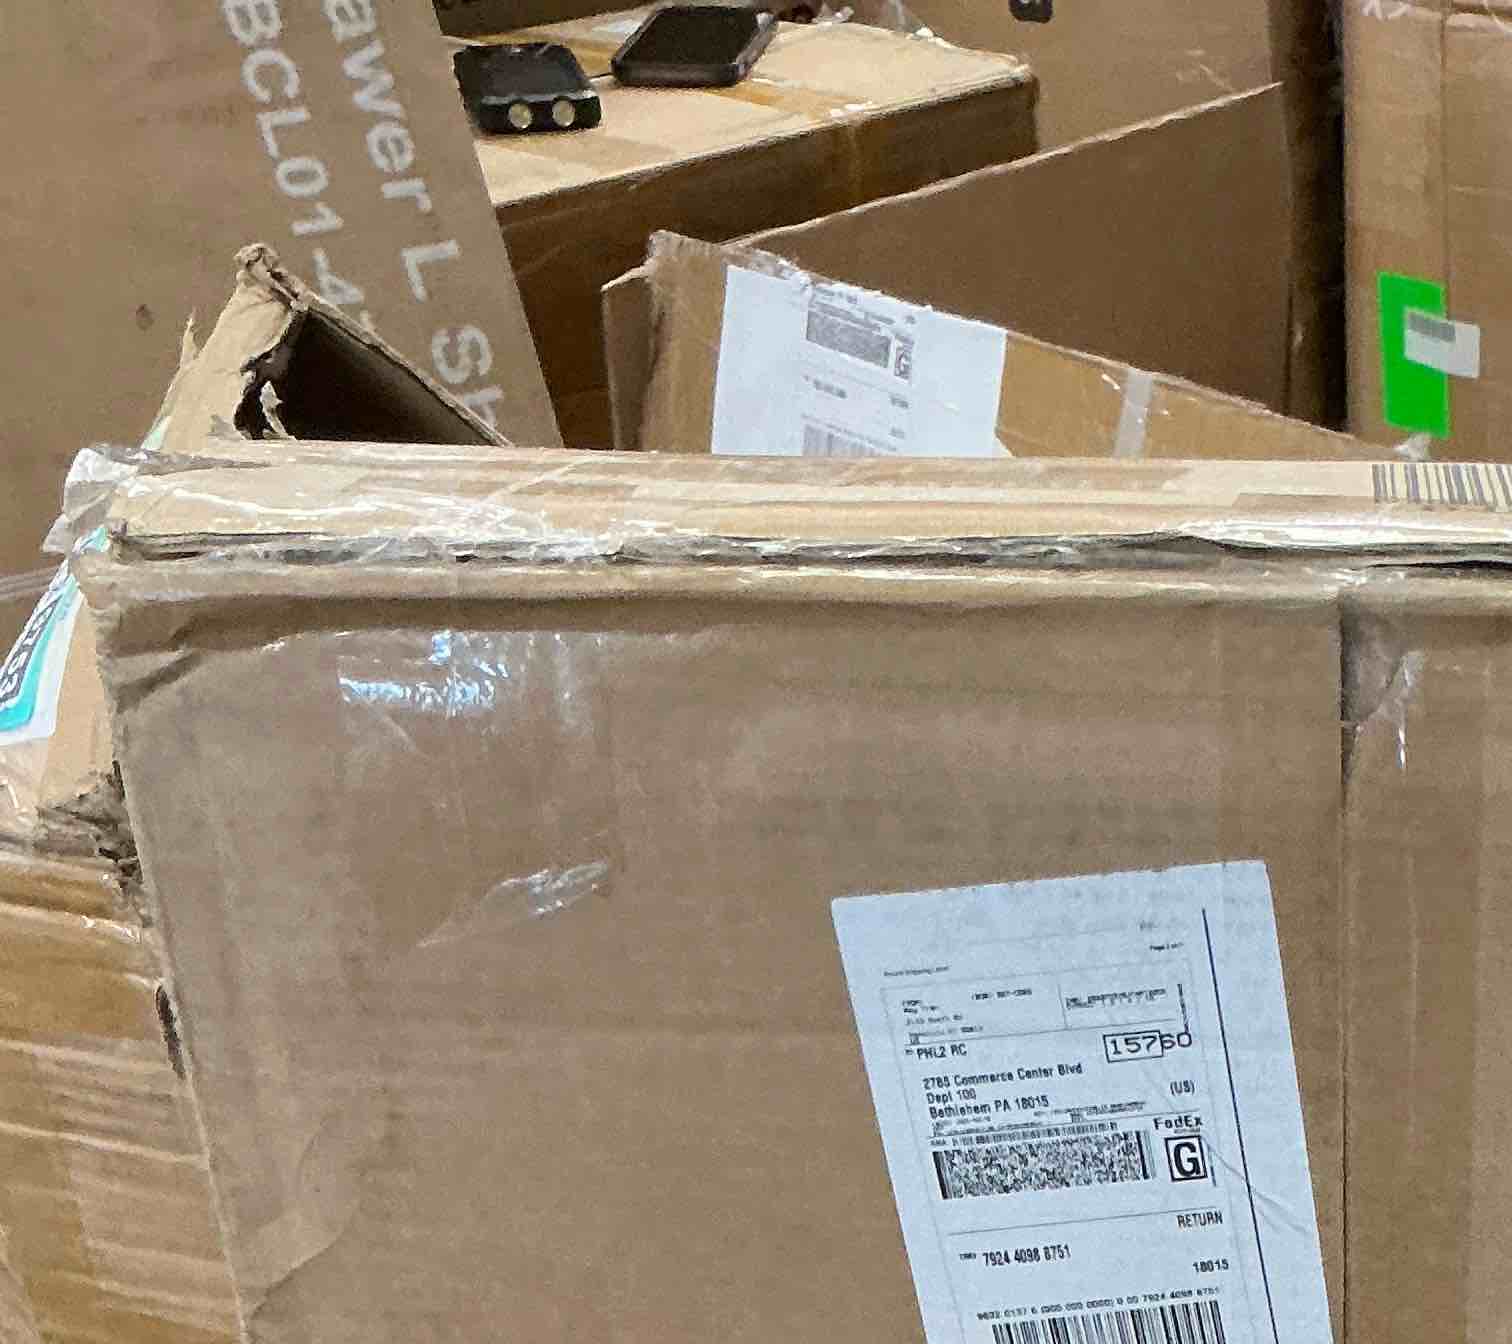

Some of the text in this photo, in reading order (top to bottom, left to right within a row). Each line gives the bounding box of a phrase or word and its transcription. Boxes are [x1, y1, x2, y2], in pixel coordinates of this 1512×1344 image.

[401, 240, 461, 302] L
[954, 1071, 1014, 1088] Commerce
[1017, 1066, 1054, 1081] Center
[1058, 1062, 1083, 1077] Blvd
[926, 1088, 977, 1105] Dept 100
[1170, 1079, 1196, 1097] (US)
[929, 1095, 1050, 1120] Bethlehem PA 18015
[1153, 1114, 1203, 1130] FedEx
[1173, 1141, 1201, 1178] G
[1177, 1211, 1224, 1229] RETURN
[983, 1250, 1010, 1267] 7924
[1014, 1247, 1041, 1263] 4098
[1043, 1244, 1072, 1261] 8751
[1192, 1258, 1230, 1274] 18015
